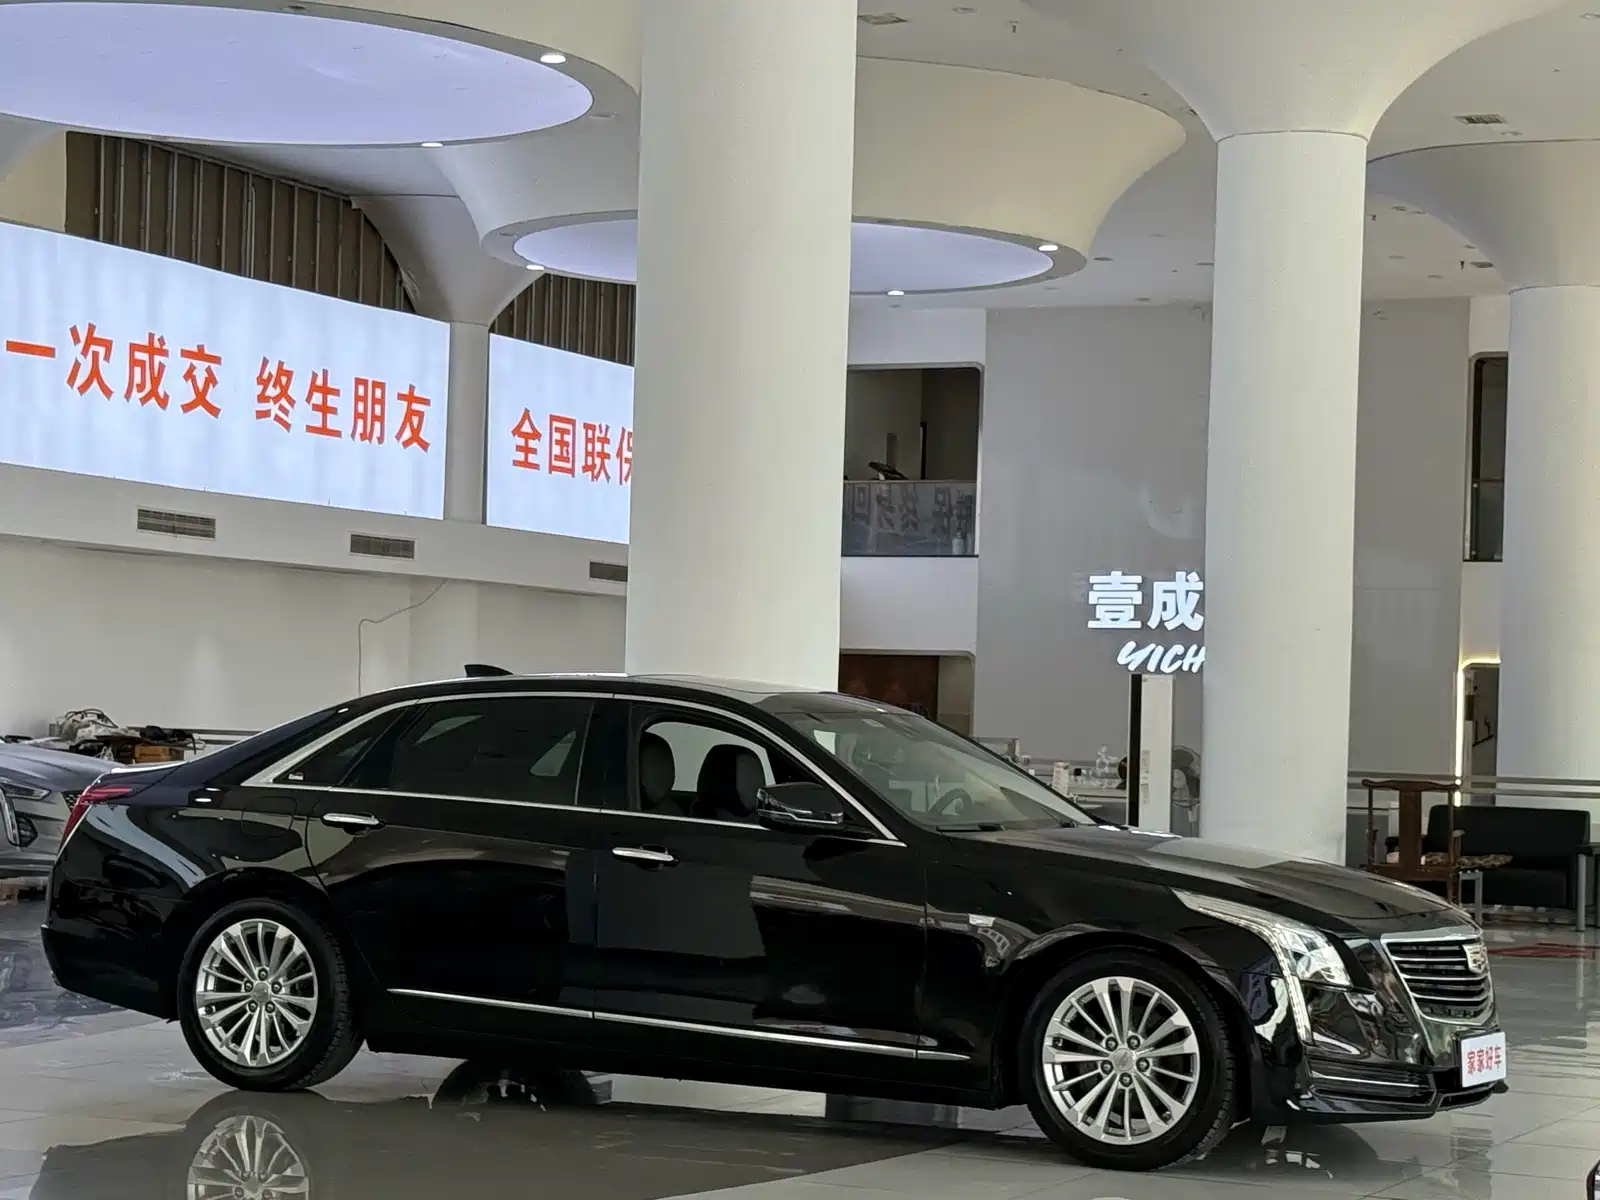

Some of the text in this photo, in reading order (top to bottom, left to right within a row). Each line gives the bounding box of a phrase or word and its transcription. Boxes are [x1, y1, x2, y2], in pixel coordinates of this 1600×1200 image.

[5, 323, 430, 452] 一次成交 终生朋友
[1087, 570, 1204, 631] 壹成
